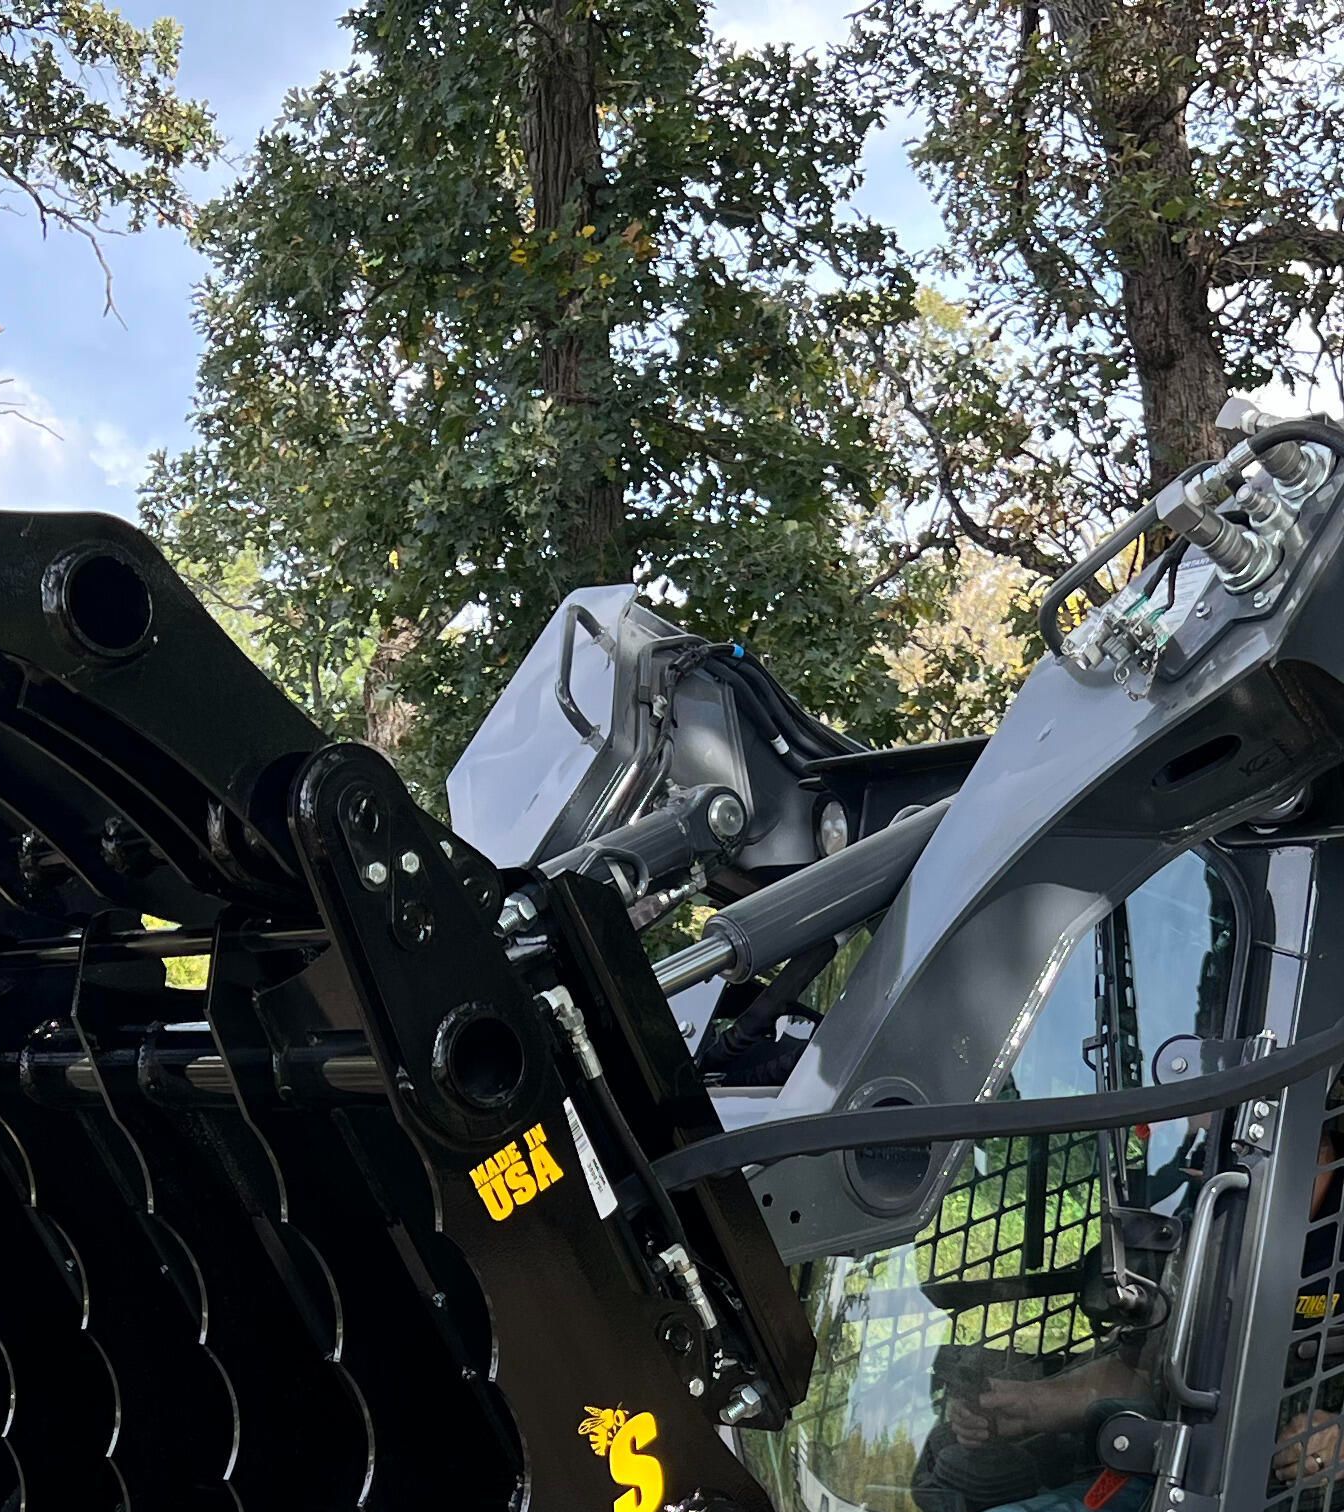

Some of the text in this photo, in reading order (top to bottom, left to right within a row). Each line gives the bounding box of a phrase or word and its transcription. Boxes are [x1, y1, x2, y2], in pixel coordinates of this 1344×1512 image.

[469, 1123, 548, 1190] MADE IN
[478, 1143, 564, 1222] USA
